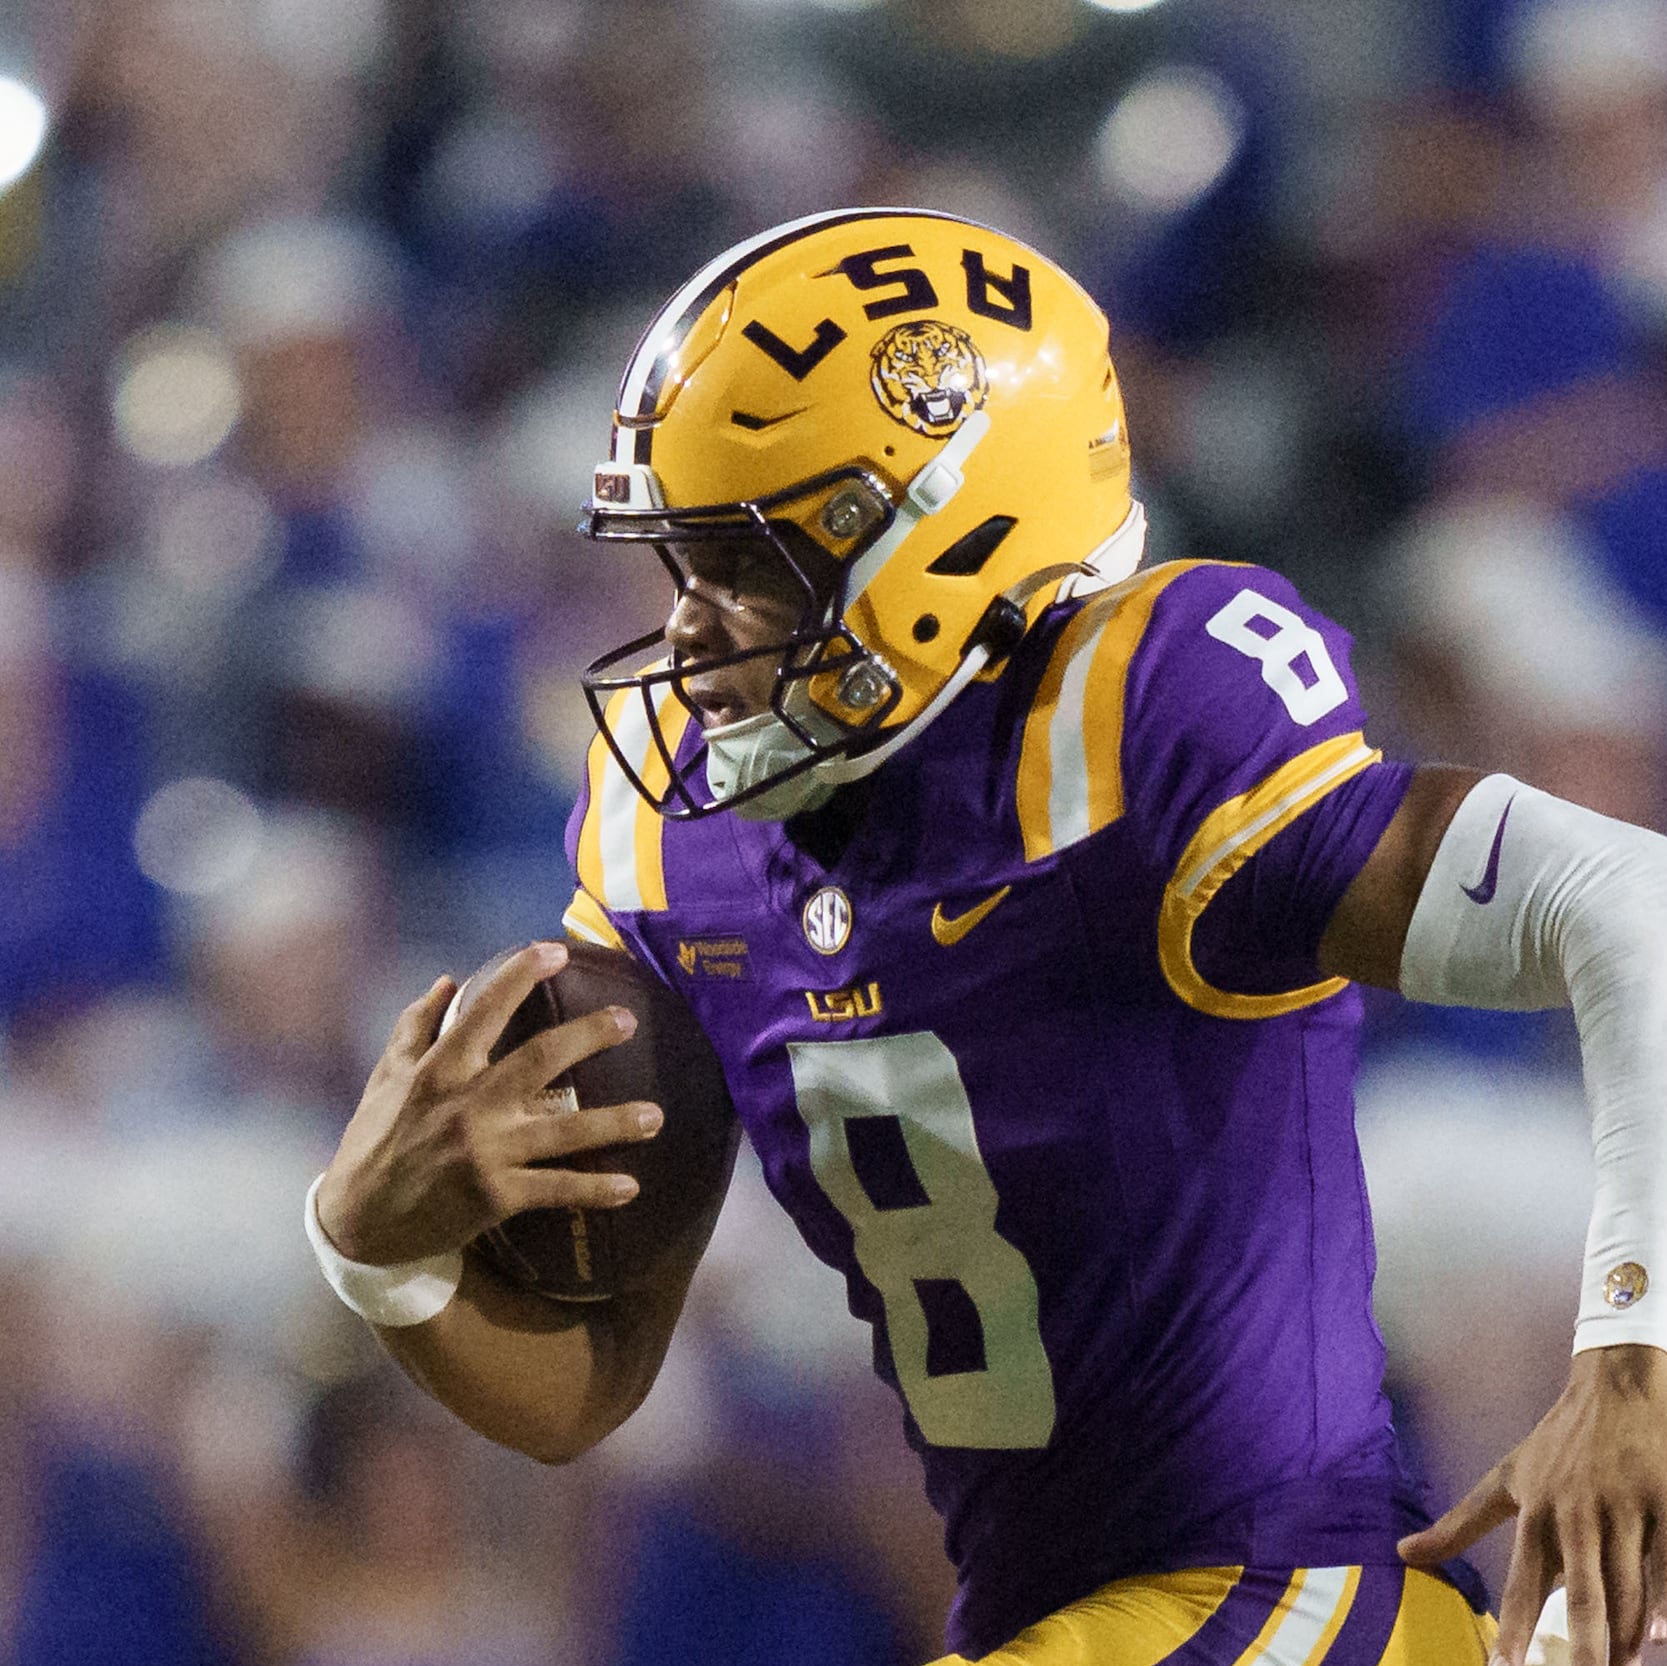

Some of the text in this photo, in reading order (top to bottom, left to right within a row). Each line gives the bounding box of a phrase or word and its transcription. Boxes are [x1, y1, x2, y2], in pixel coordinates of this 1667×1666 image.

[741, 244, 1032, 382] LSU
[1205, 588, 1349, 727] 8
[807, 890, 849, 950] SEC
[805, 981, 883, 1022] LSU
[787, 1031, 1056, 1450] 8
